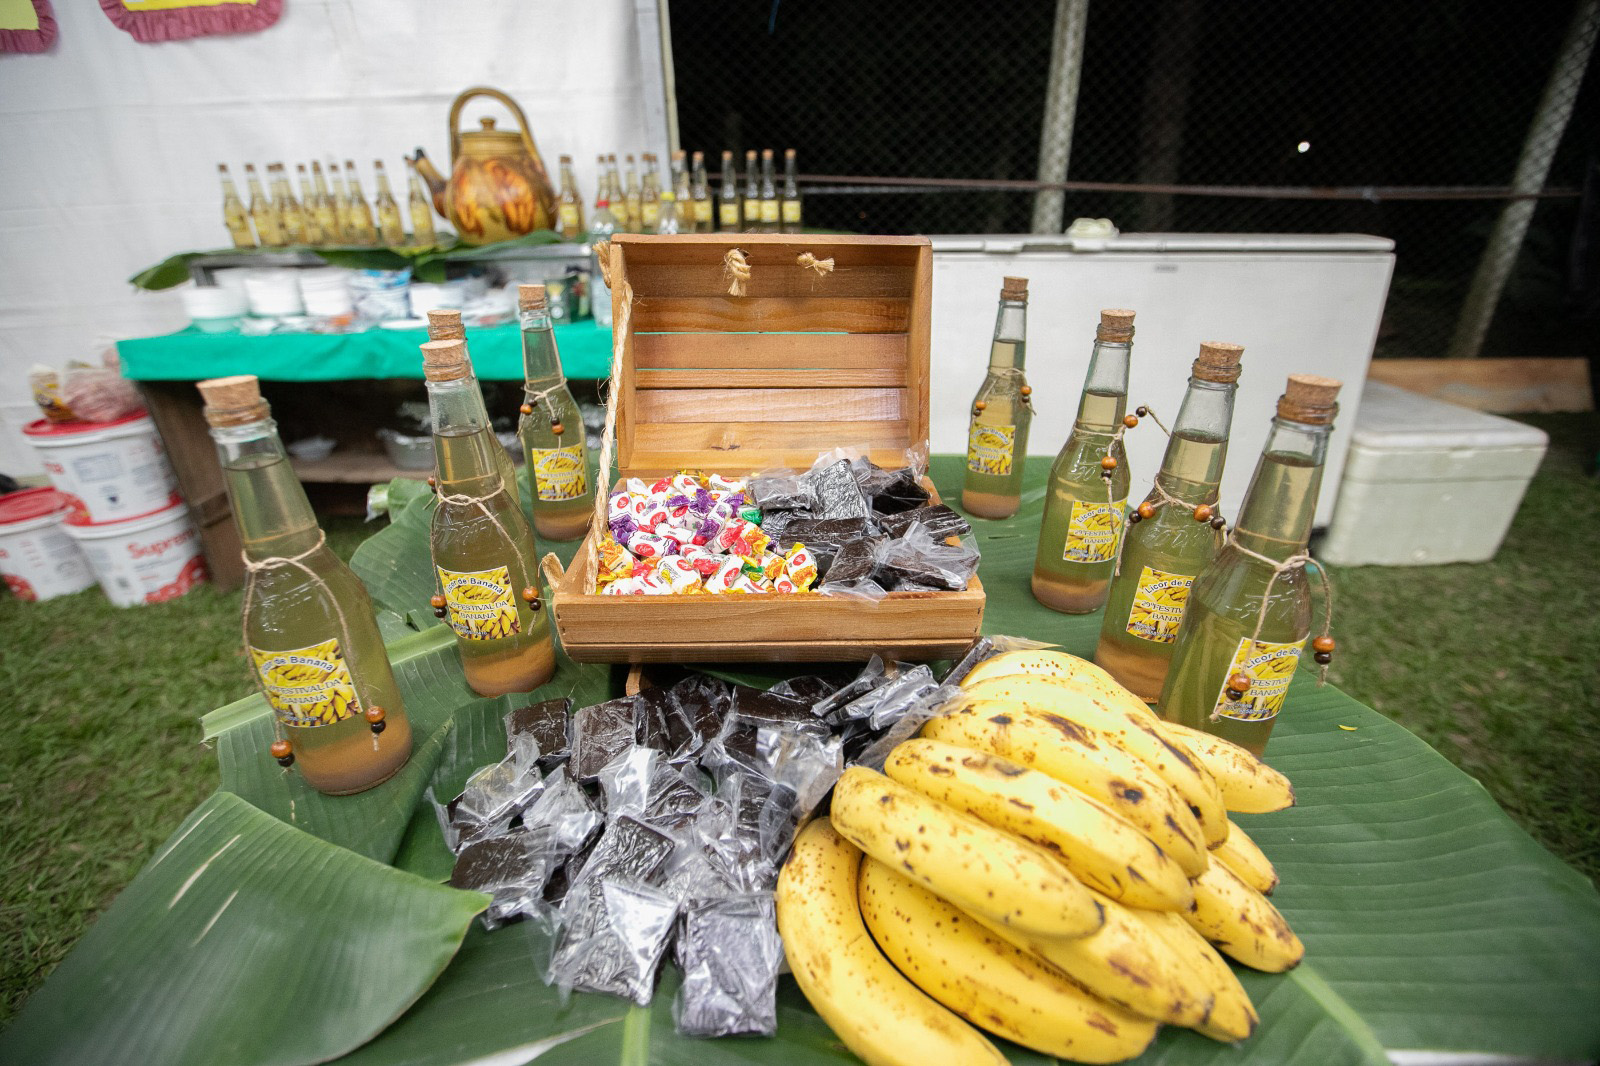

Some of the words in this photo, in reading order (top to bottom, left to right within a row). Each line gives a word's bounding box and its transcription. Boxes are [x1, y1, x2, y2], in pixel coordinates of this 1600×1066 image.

[470, 577, 503, 594] Banana
[1145, 581, 1168, 594] Licor
[460, 612, 497, 620] BANANA
[1276, 648, 1288, 657] de
[289, 656, 334, 672] Banana
[278, 685, 326, 695] FESTIVAL
[325, 679, 342, 689] DA
[280, 694, 328, 704] BANANA
